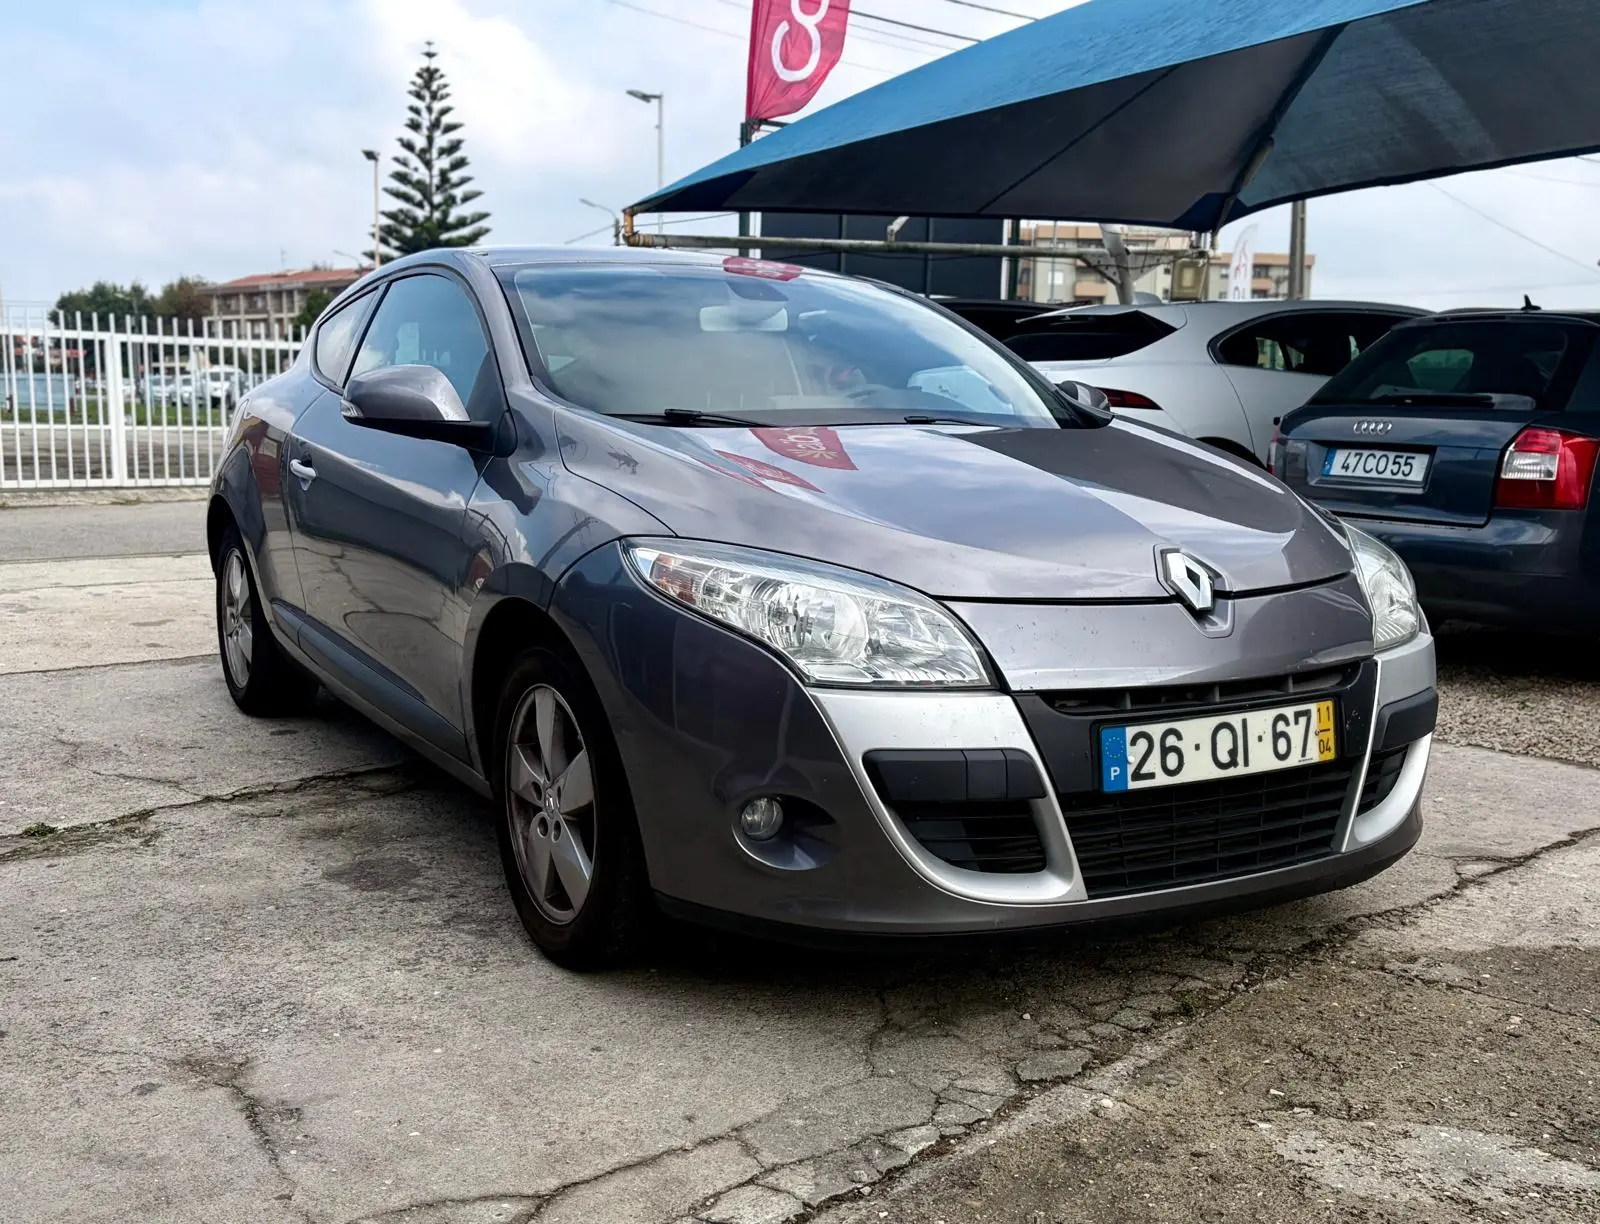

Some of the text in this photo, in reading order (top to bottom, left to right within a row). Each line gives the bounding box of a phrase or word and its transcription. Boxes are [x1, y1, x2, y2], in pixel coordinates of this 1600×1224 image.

[1317, 706, 1332, 724] 11
[1318, 738, 1332, 755] 04
[1110, 766, 1121, 781] P
